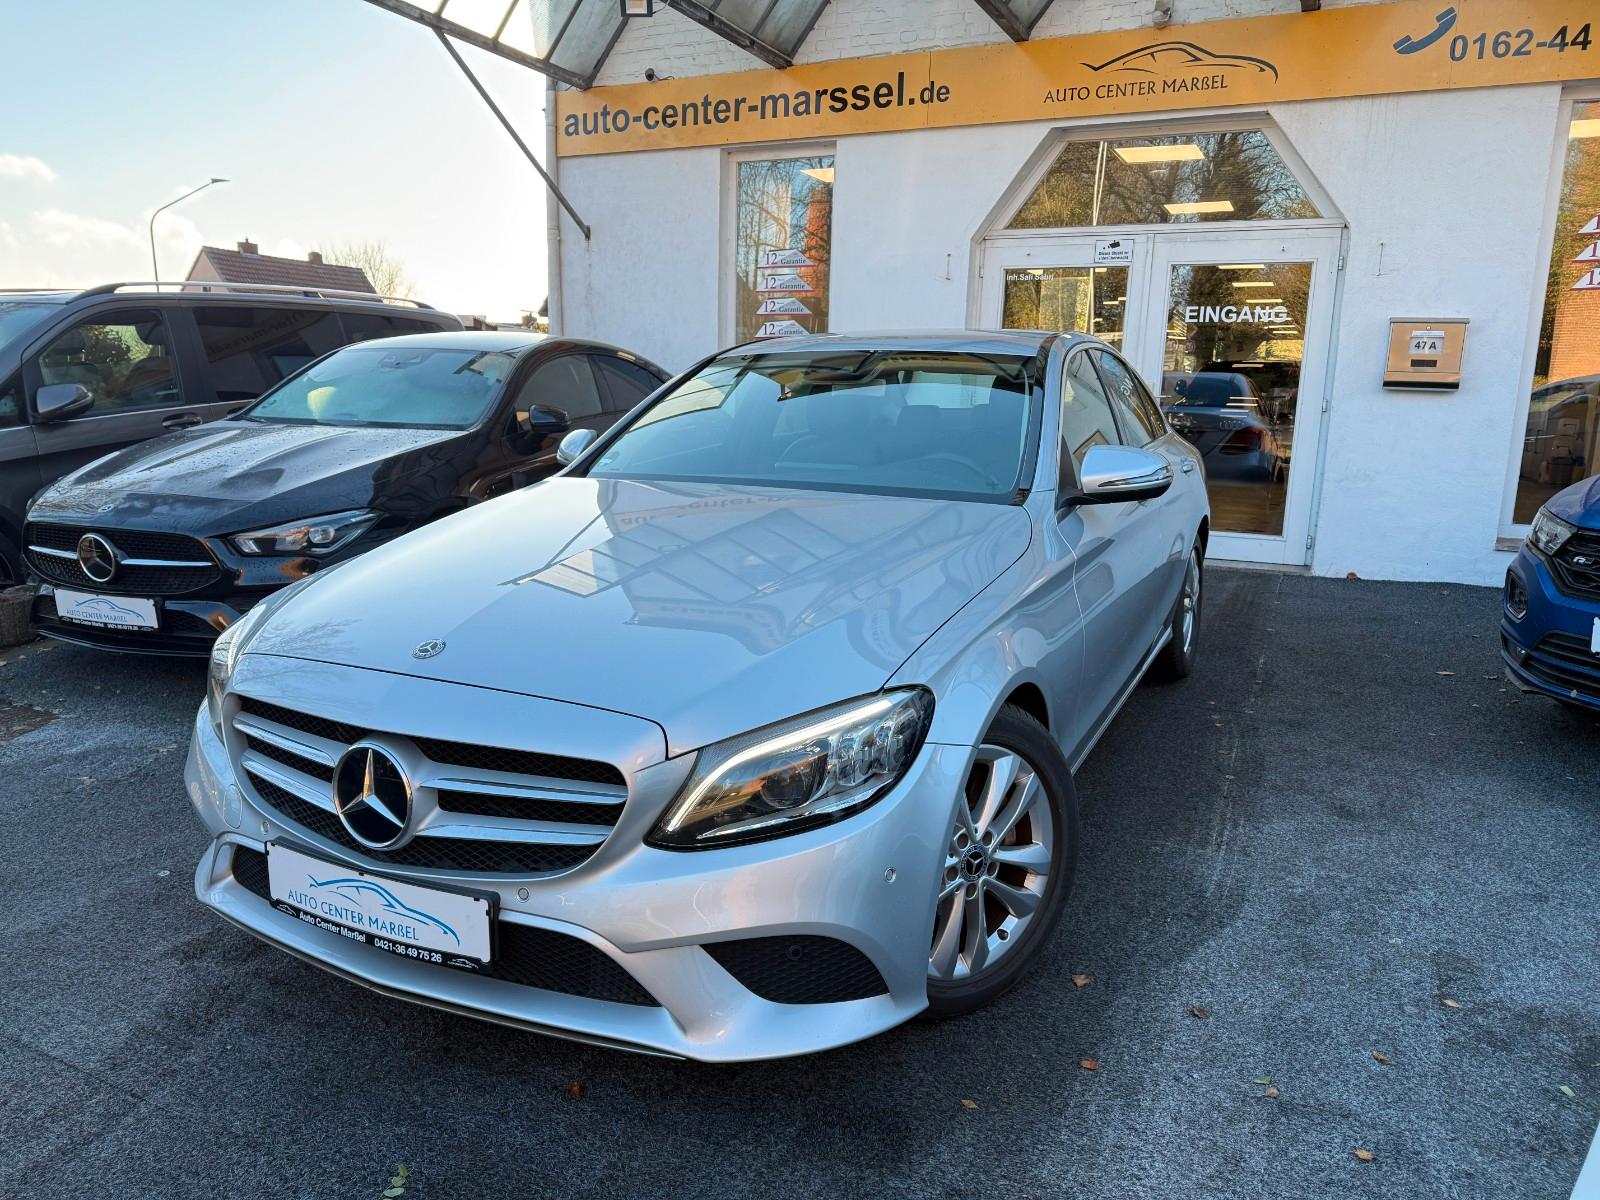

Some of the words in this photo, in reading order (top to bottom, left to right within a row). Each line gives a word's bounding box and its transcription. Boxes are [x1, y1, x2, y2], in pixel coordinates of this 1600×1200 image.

[1449, 22, 1592, 62] 0162-44
[1043, 86, 1090, 103] AUTO
[1095, 80, 1156, 99] CENTER
[1162, 74, 1228, 94] MARßEL
[563, 71, 950, 137] auto-center-marssel.de
[765, 252, 778, 265] 12
[780, 257, 807, 265] Garantie
[763, 276, 777, 290] 12
[779, 282, 805, 290] Garantie
[763, 300, 777, 313] 12
[1184, 305, 1288, 323] EINGANG
[763, 323, 776, 336] 12
[778, 328, 804, 336] Garantie
[1414, 341, 1427, 350] 47
[1428, 341, 1437, 351] A
[66, 609, 82, 617] AUTO
[81, 611, 103, 620] CENTER
[287, 888, 317, 910] AUTO
[320, 901, 364, 927] CENTER
[368, 915, 420, 941] MARßEL
[299, 911, 316, 926] Auto
[315, 916, 340, 934] Center
[340, 926, 366, 943] Marßel
[374, 937, 406, 955] 0421-36
[406, 946, 418, 959] 49
[418, 948, 430, 961] 75
[429, 951, 443, 963] 26
